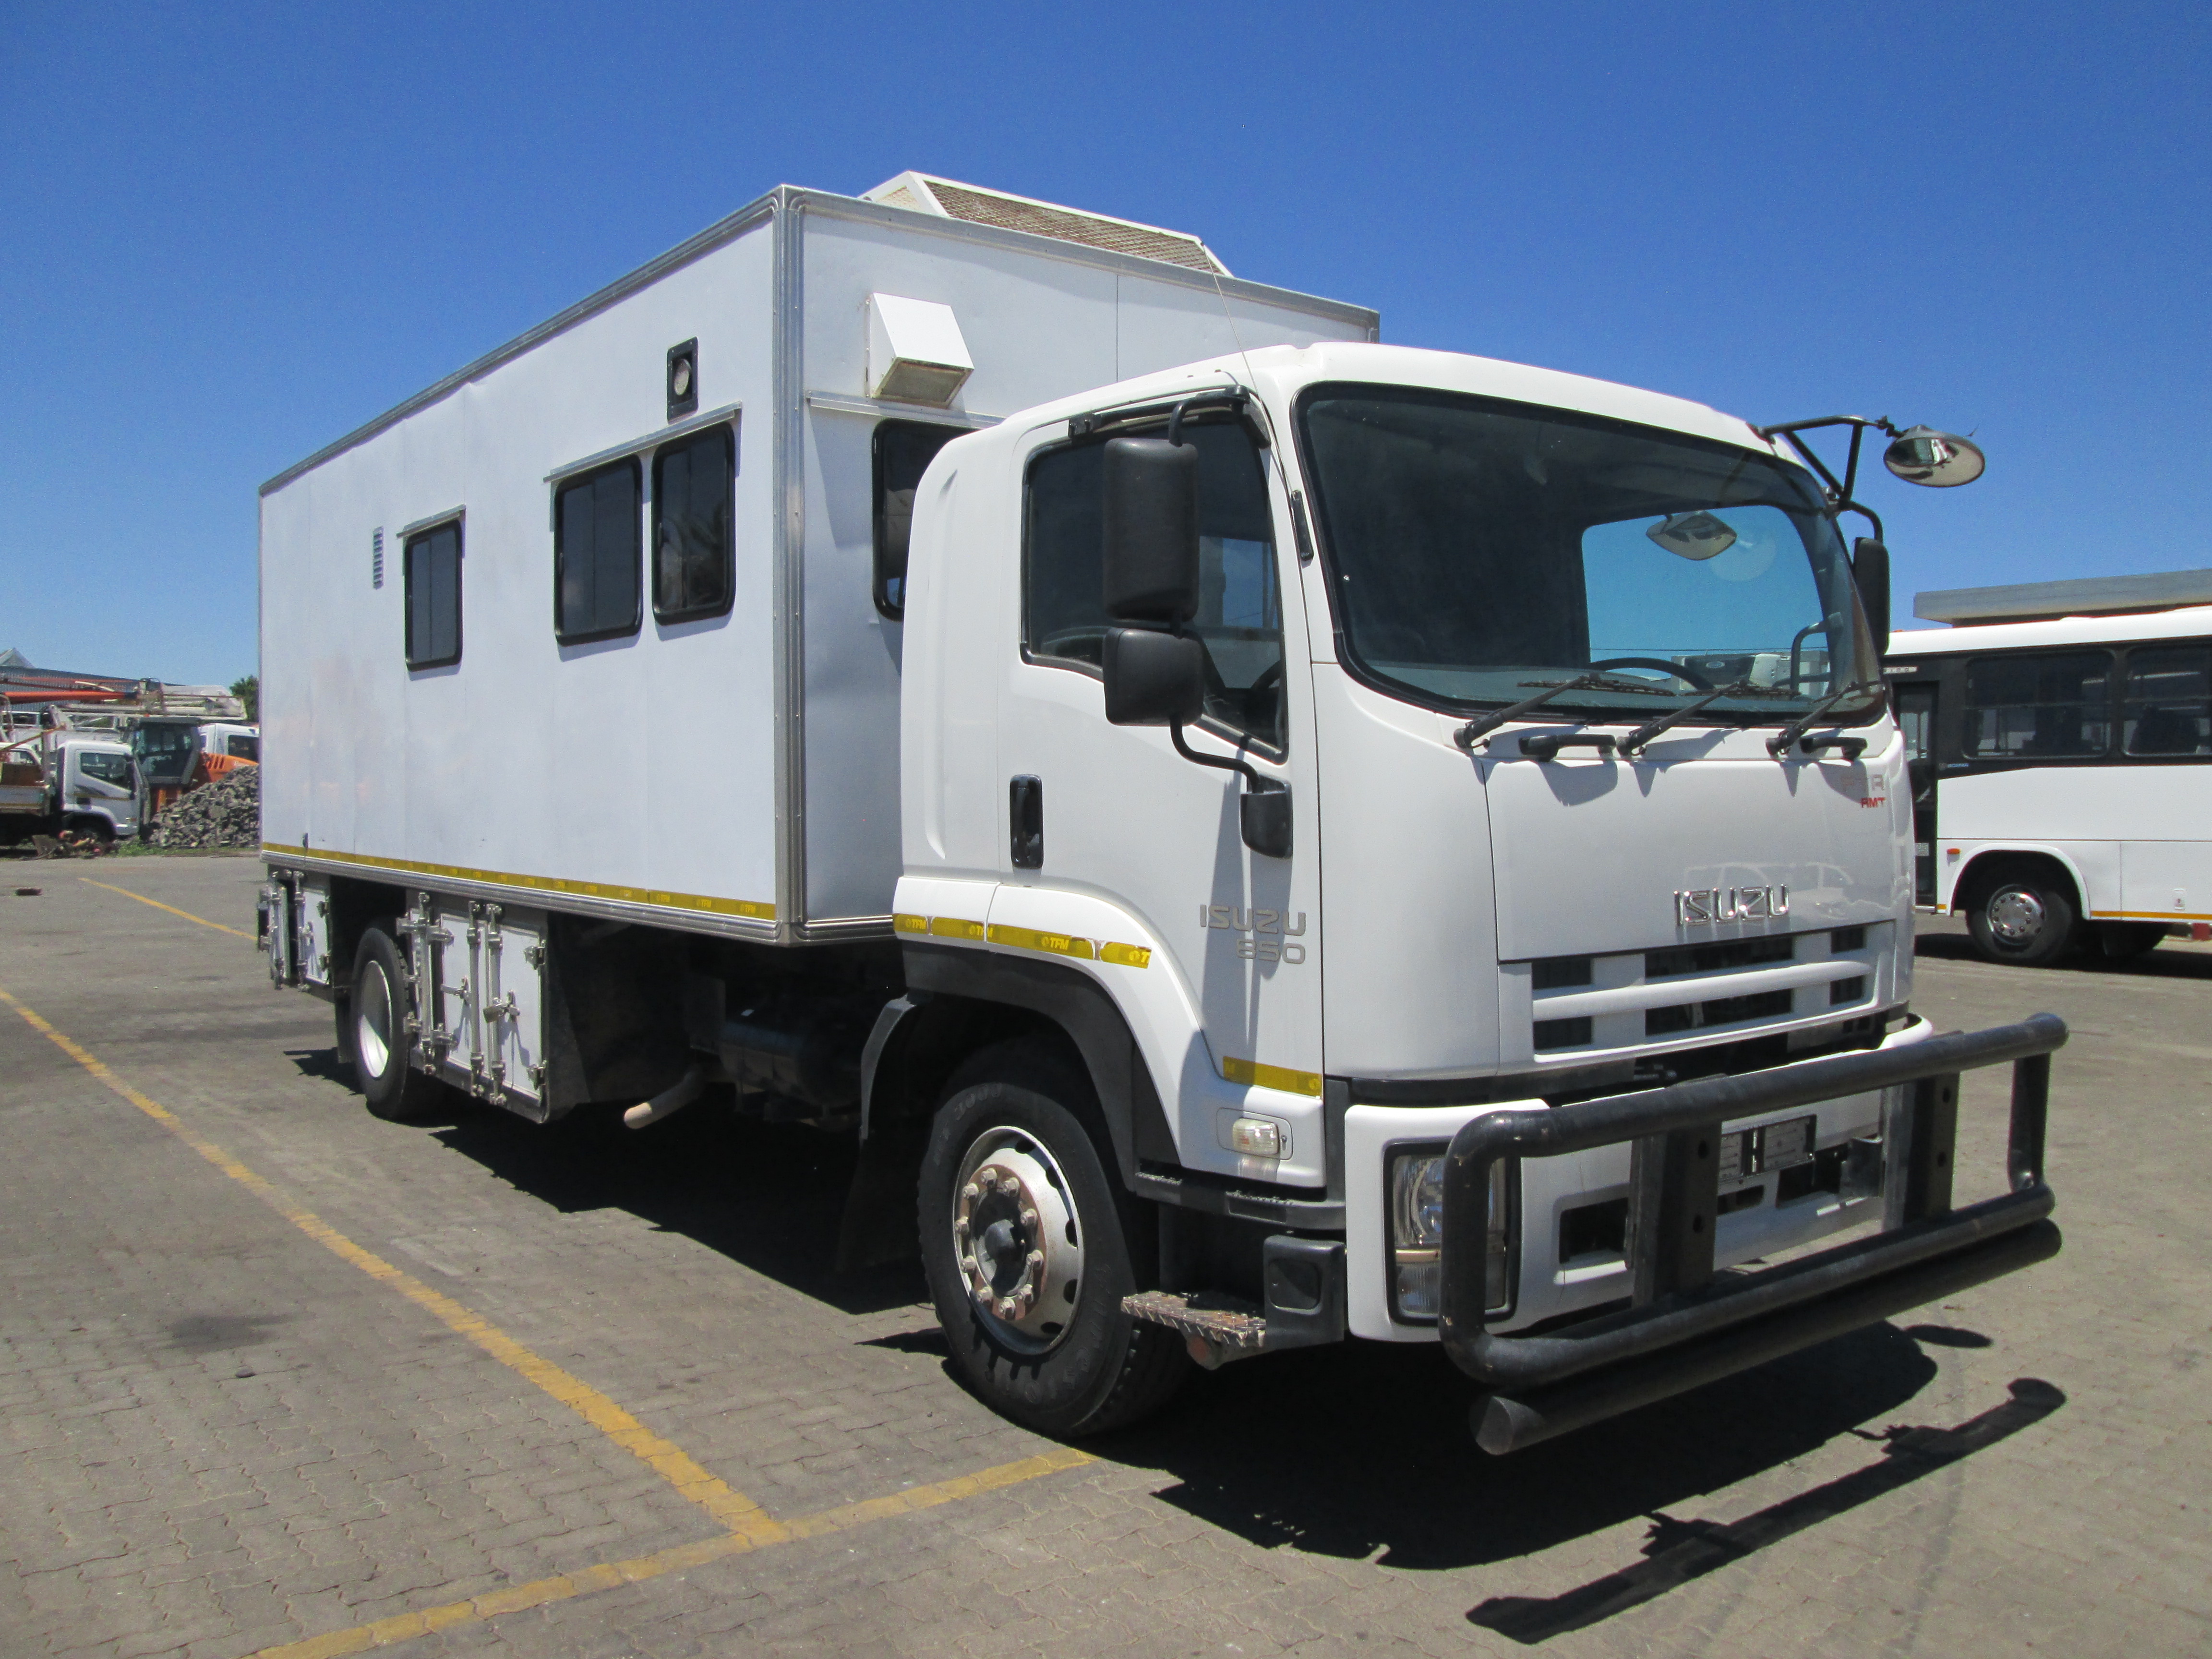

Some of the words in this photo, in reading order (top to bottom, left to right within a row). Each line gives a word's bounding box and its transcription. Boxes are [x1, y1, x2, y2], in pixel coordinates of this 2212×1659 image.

[1673, 883, 1790, 926] ISUZU
[1200, 904, 1306, 937] ISUZU
[1050, 937, 1070, 950] TFM
[1236, 938, 1306, 965] 850
